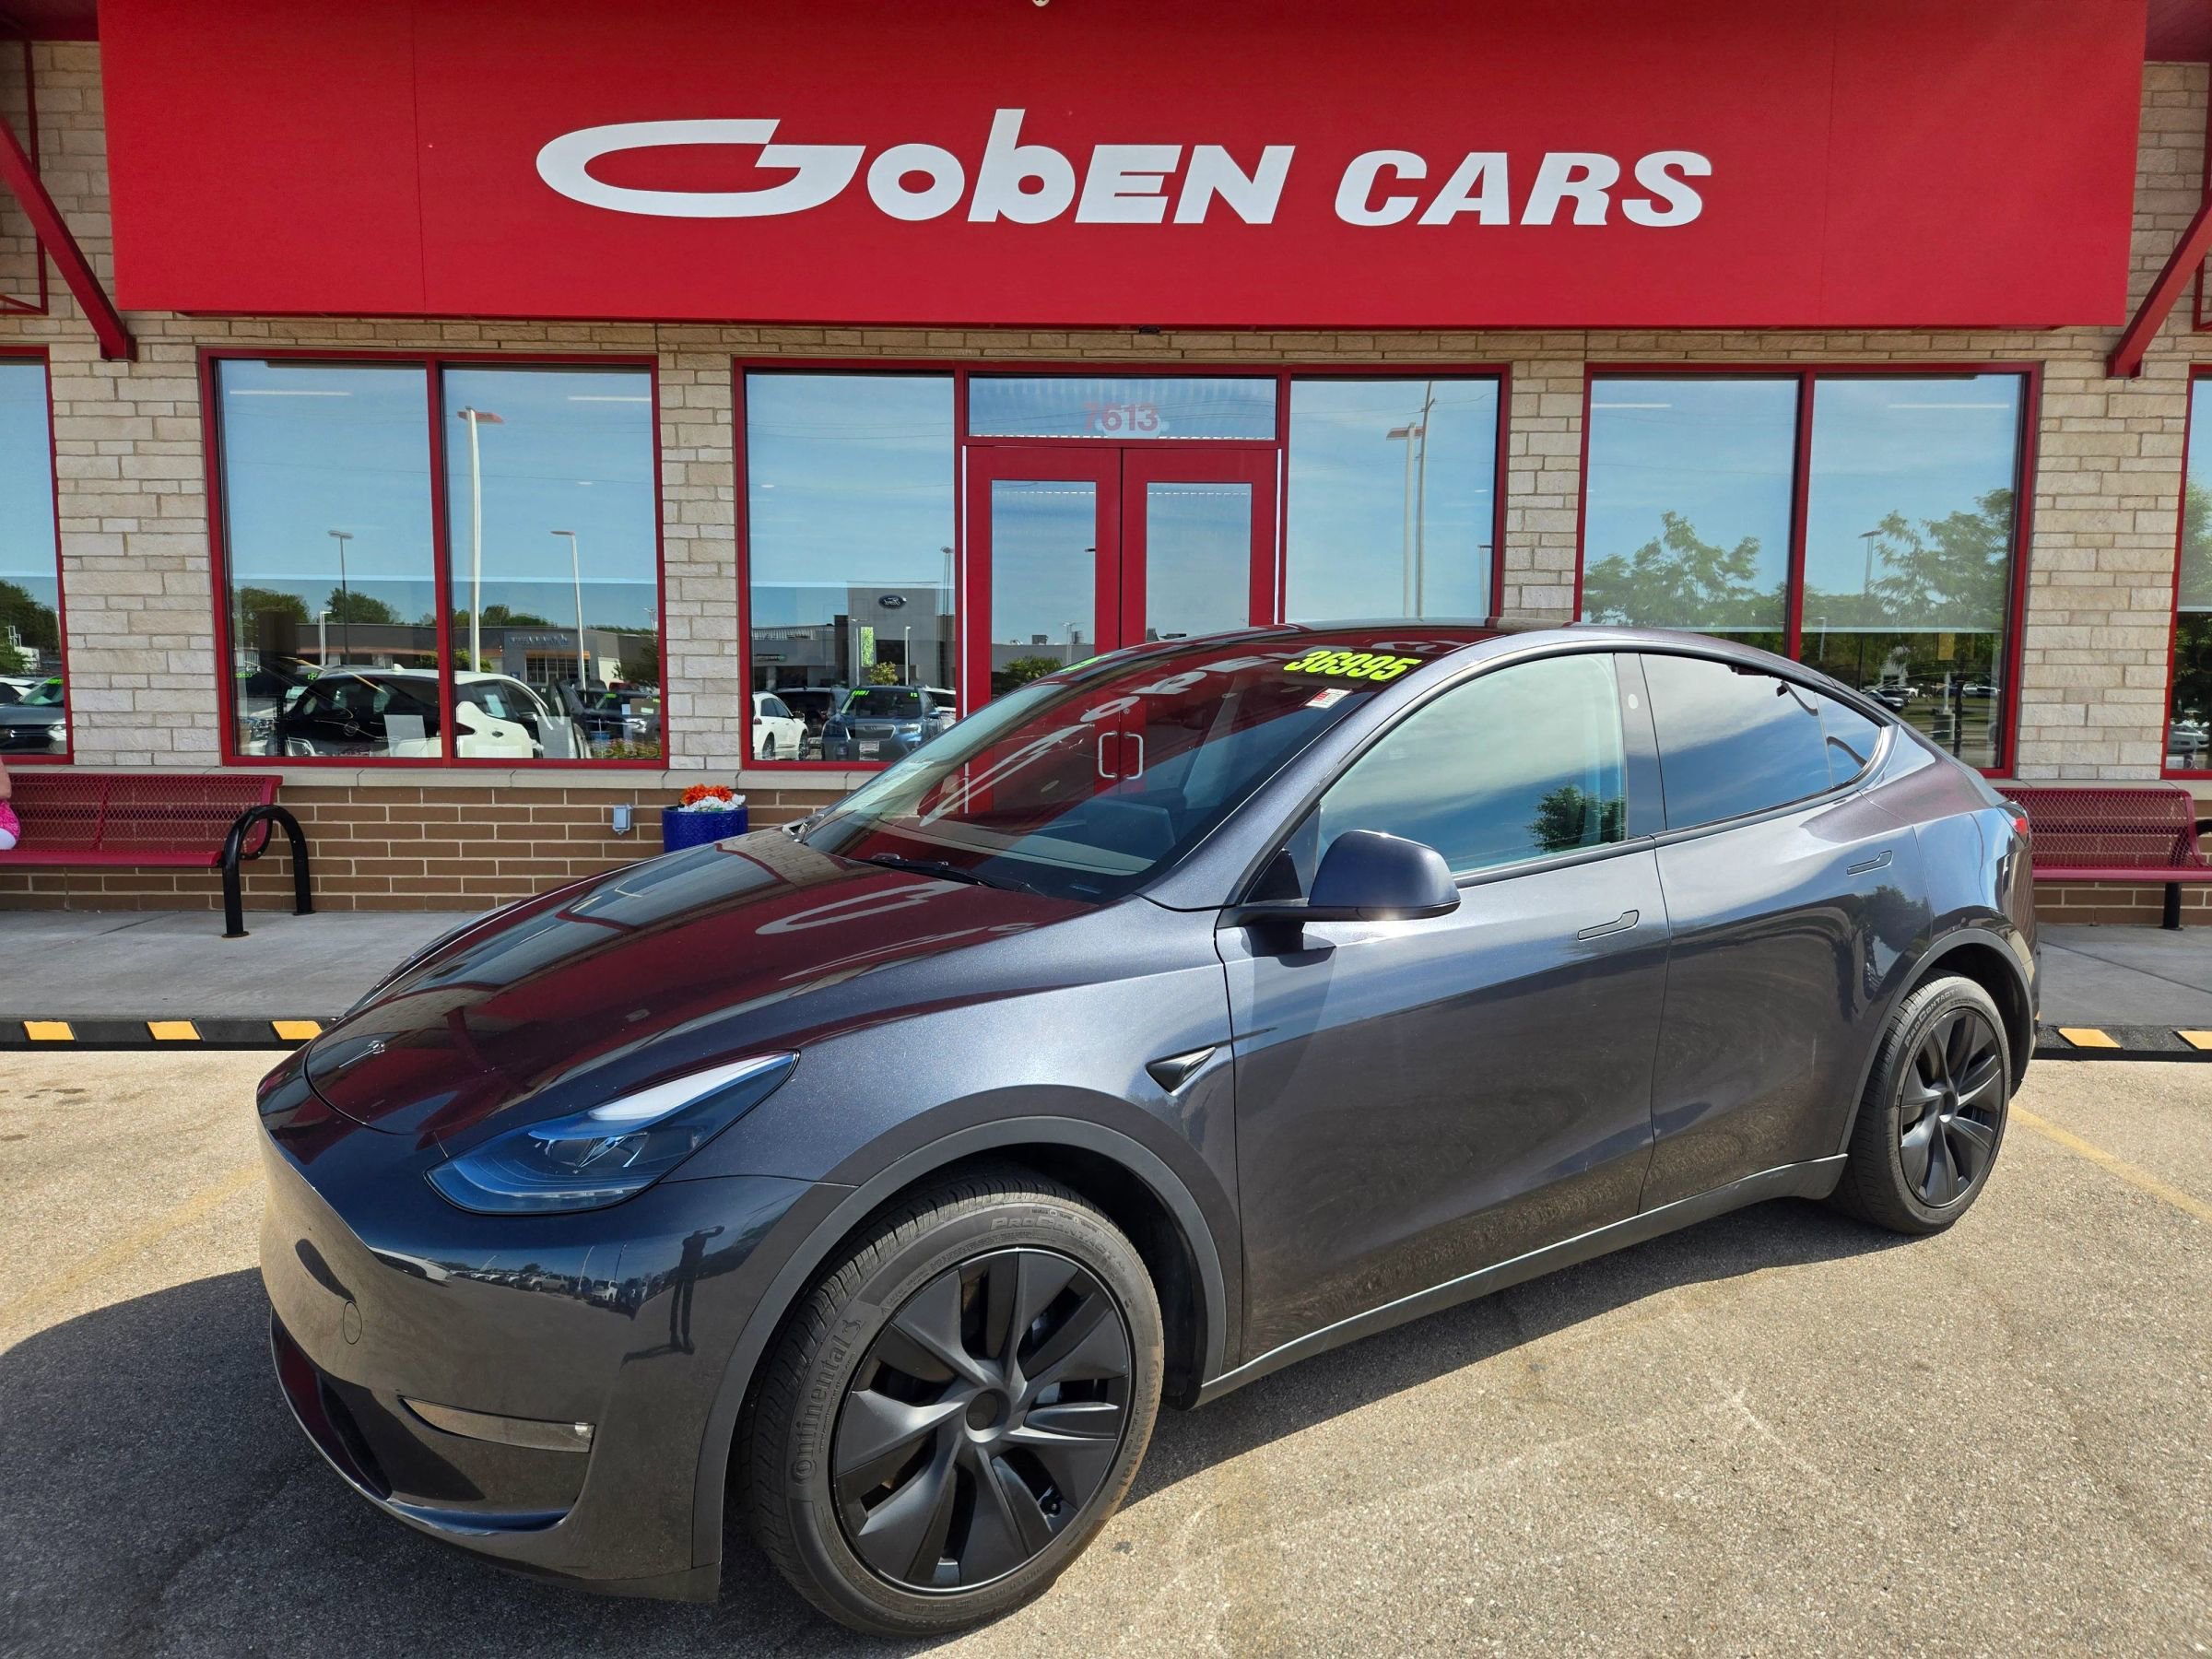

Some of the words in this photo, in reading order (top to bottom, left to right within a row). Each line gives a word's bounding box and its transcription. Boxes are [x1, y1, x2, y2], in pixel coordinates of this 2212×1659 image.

[1334, 149, 1712, 228] CARS
[1283, 650, 1422, 681] 36995
[791, 1335, 853, 1485] Continental
